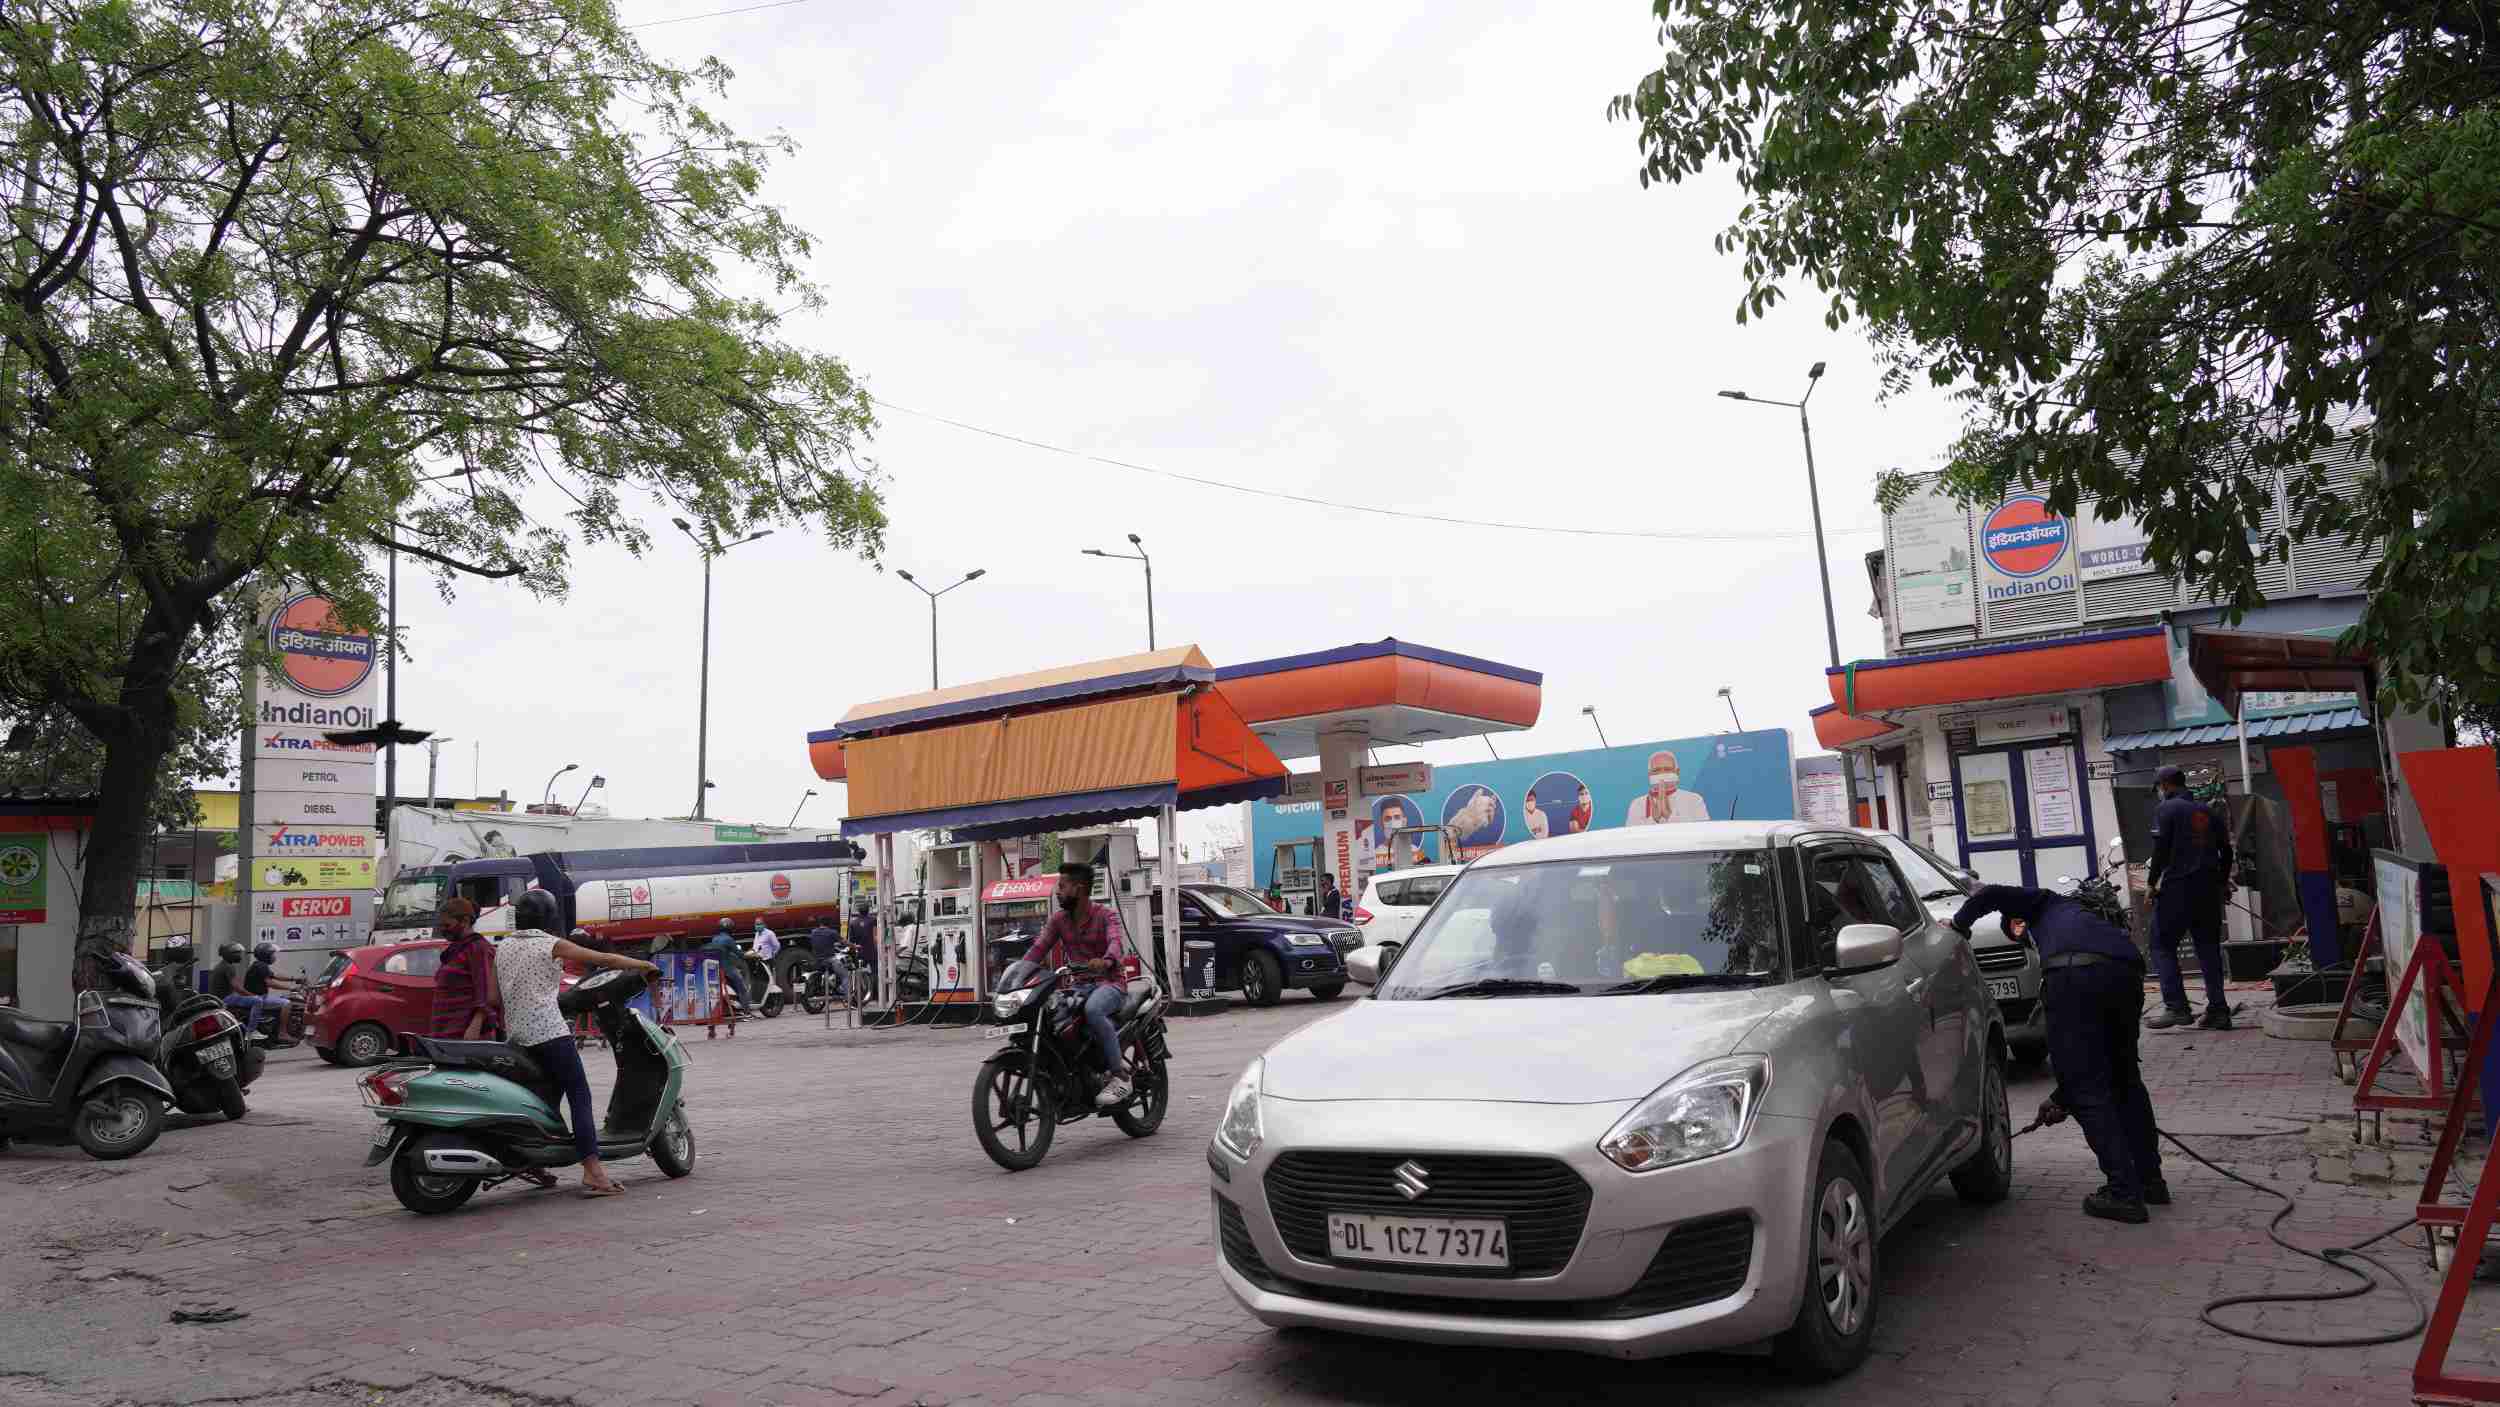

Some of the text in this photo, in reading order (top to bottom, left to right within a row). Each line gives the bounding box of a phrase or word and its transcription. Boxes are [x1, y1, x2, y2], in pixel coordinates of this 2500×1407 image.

[1988, 525, 2062, 549] इंडियनऑयल
[2090, 544, 2144, 564] WORLD-C
[1988, 575, 2075, 599] IndianOil
[264, 700, 373, 728] IndianOil
[302, 771, 338, 783] PETROL
[303, 804, 337, 814] DIESEL
[270, 825, 365, 847] XTRAPOWER
[289, 898, 343, 916] SERVO
[1344, 1222, 1374, 1251] DL
[1437, 1228, 1505, 1258] 7374
